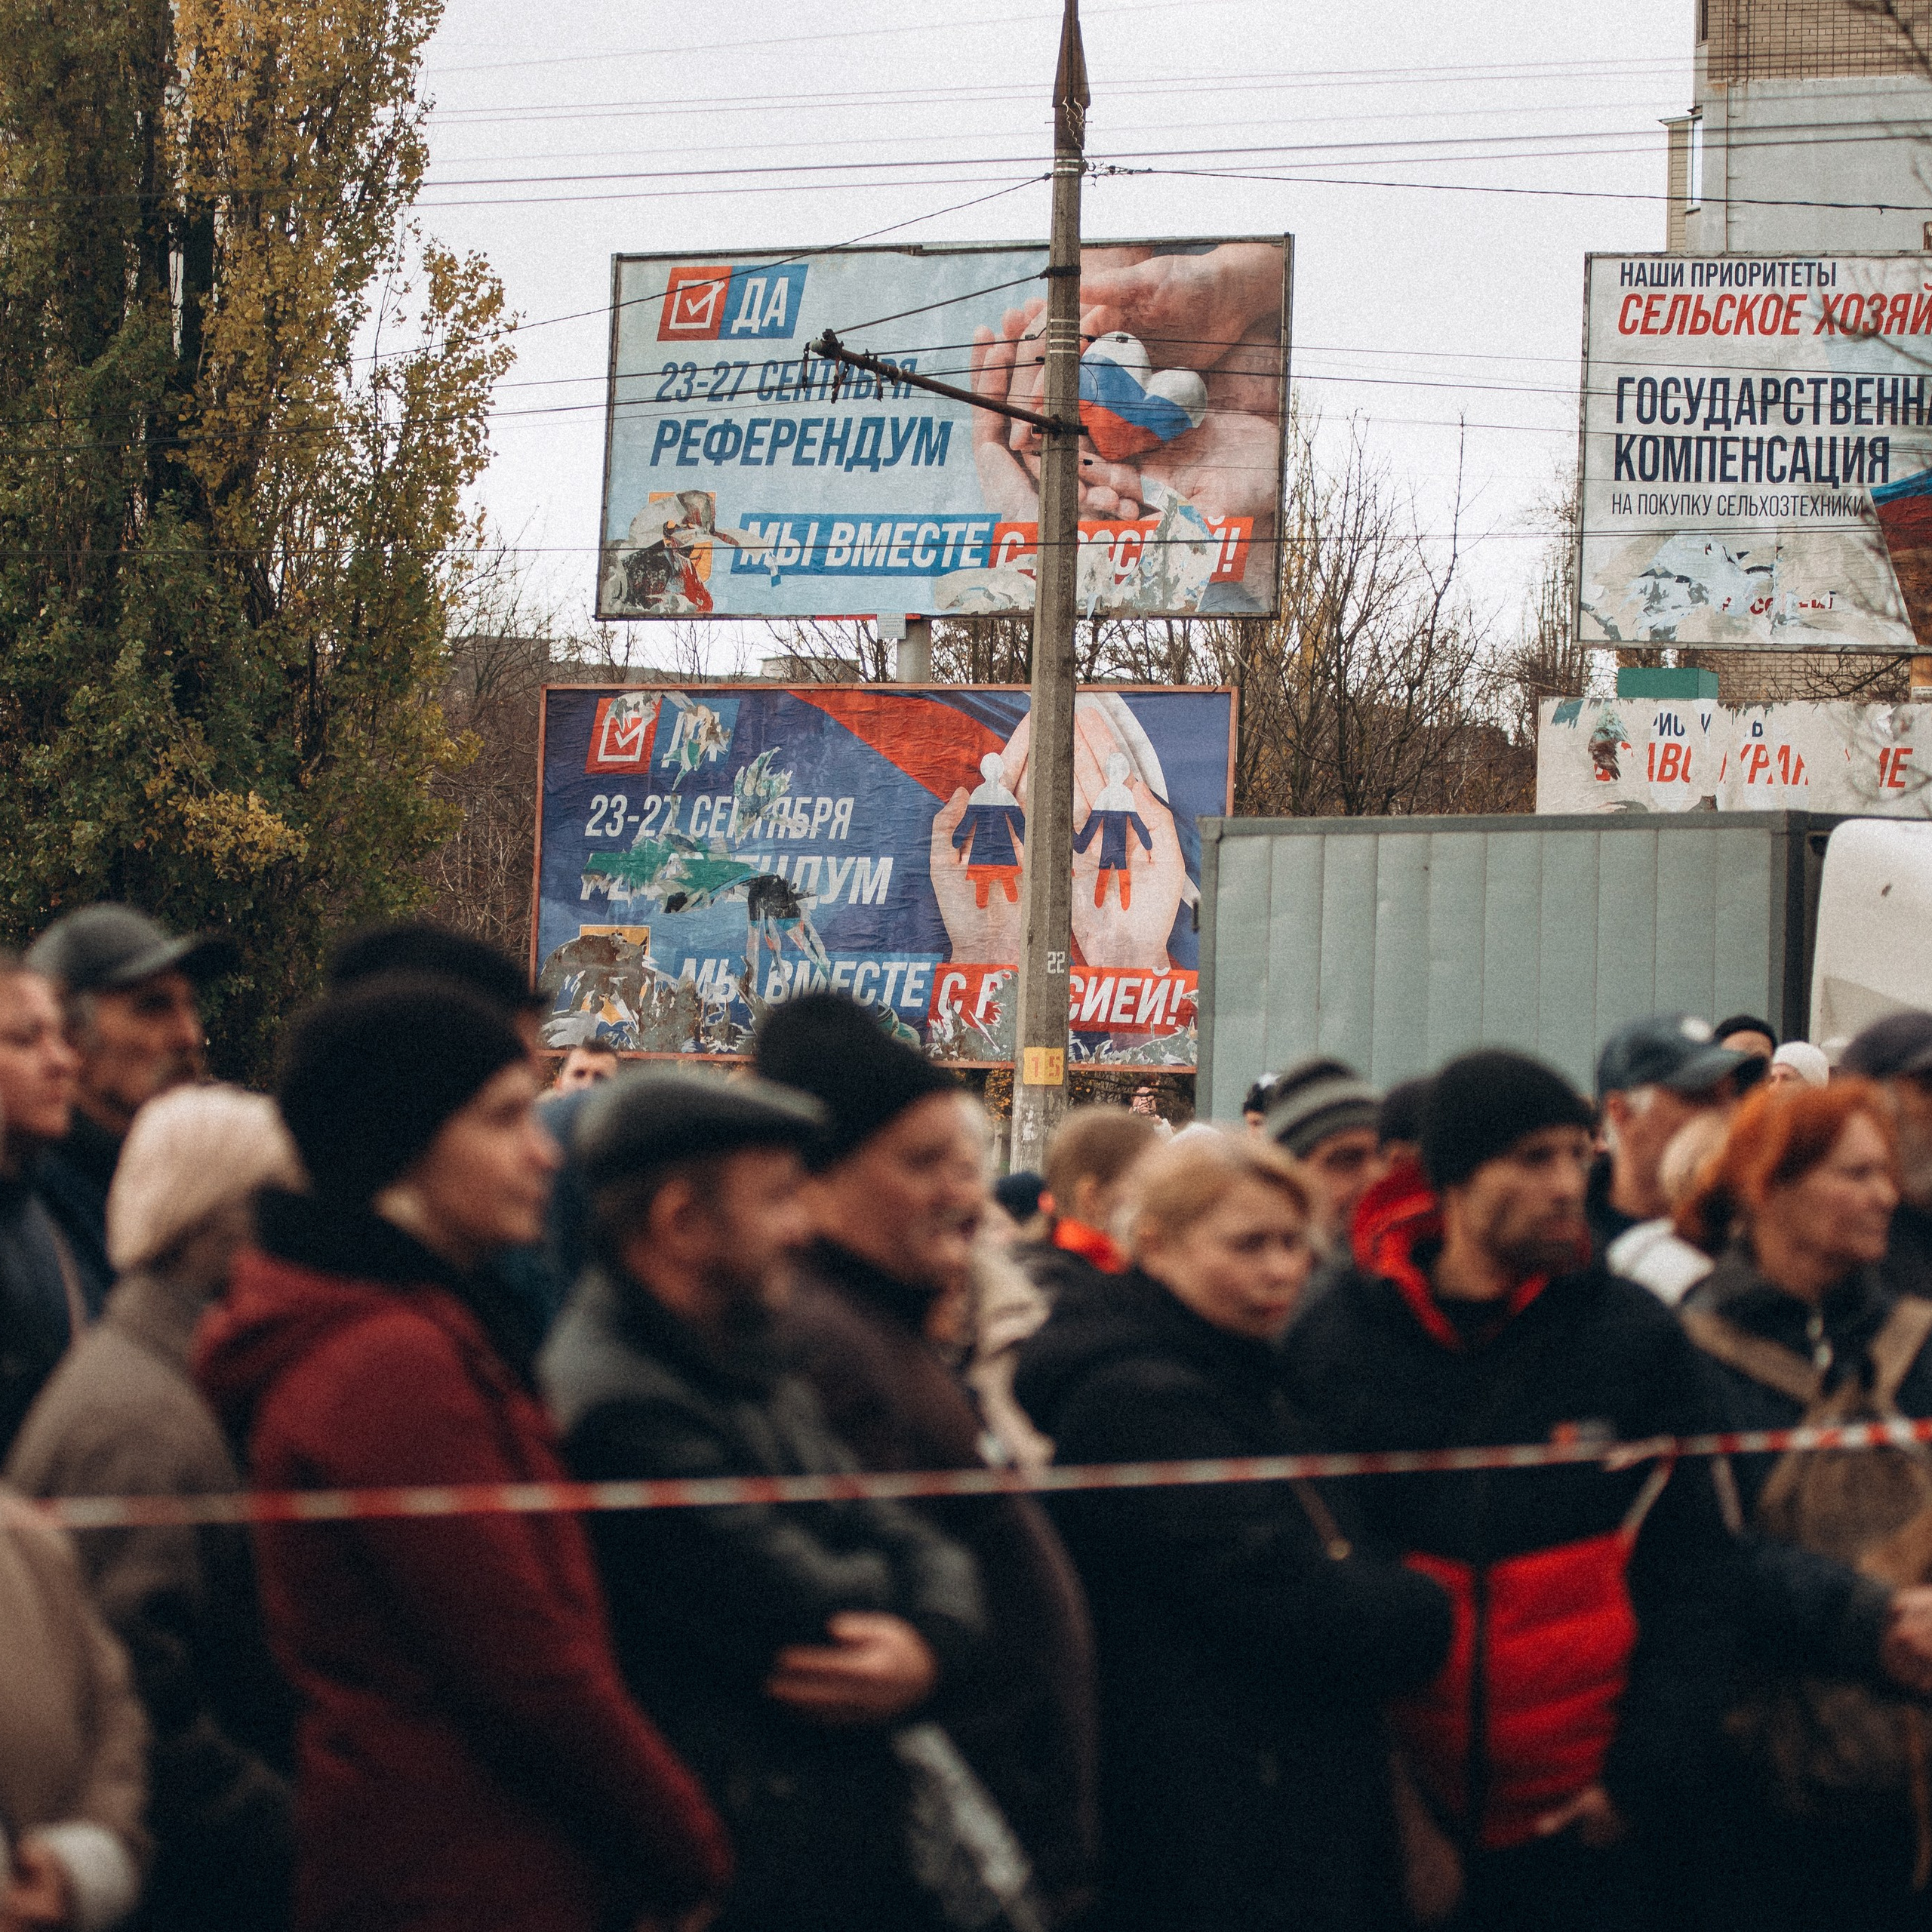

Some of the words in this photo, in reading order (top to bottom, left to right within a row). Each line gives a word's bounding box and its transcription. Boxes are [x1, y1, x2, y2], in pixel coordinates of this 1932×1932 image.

[1620, 262, 1684, 287] НАШИ
[1691, 262, 1836, 288] ПРИОРИТЕТЫ
[731, 276, 789, 334] ДА
[1617, 293, 1808, 336] СЕЛЬСКОЕ
[654, 361, 750, 403] 23-27
[1615, 376, 1932, 432] ГОСУДАРСТВЕНН
[649, 417, 954, 473] РЕФЕРЕНДУМ
[1614, 434, 1890, 490] КОМПЕНСАЦИЯ
[1612, 493, 1632, 515] НА
[1638, 493, 1712, 516] ПОКУПКУ
[1717, 494, 1864, 518] СЕЛЬХОЗТЕХНИКИ
[740, 521, 820, 567] МЫ
[824, 521, 990, 568] ВМЕСТЕ
[584, 794, 682, 838] 23-27
[1047, 951, 1066, 974] 22
